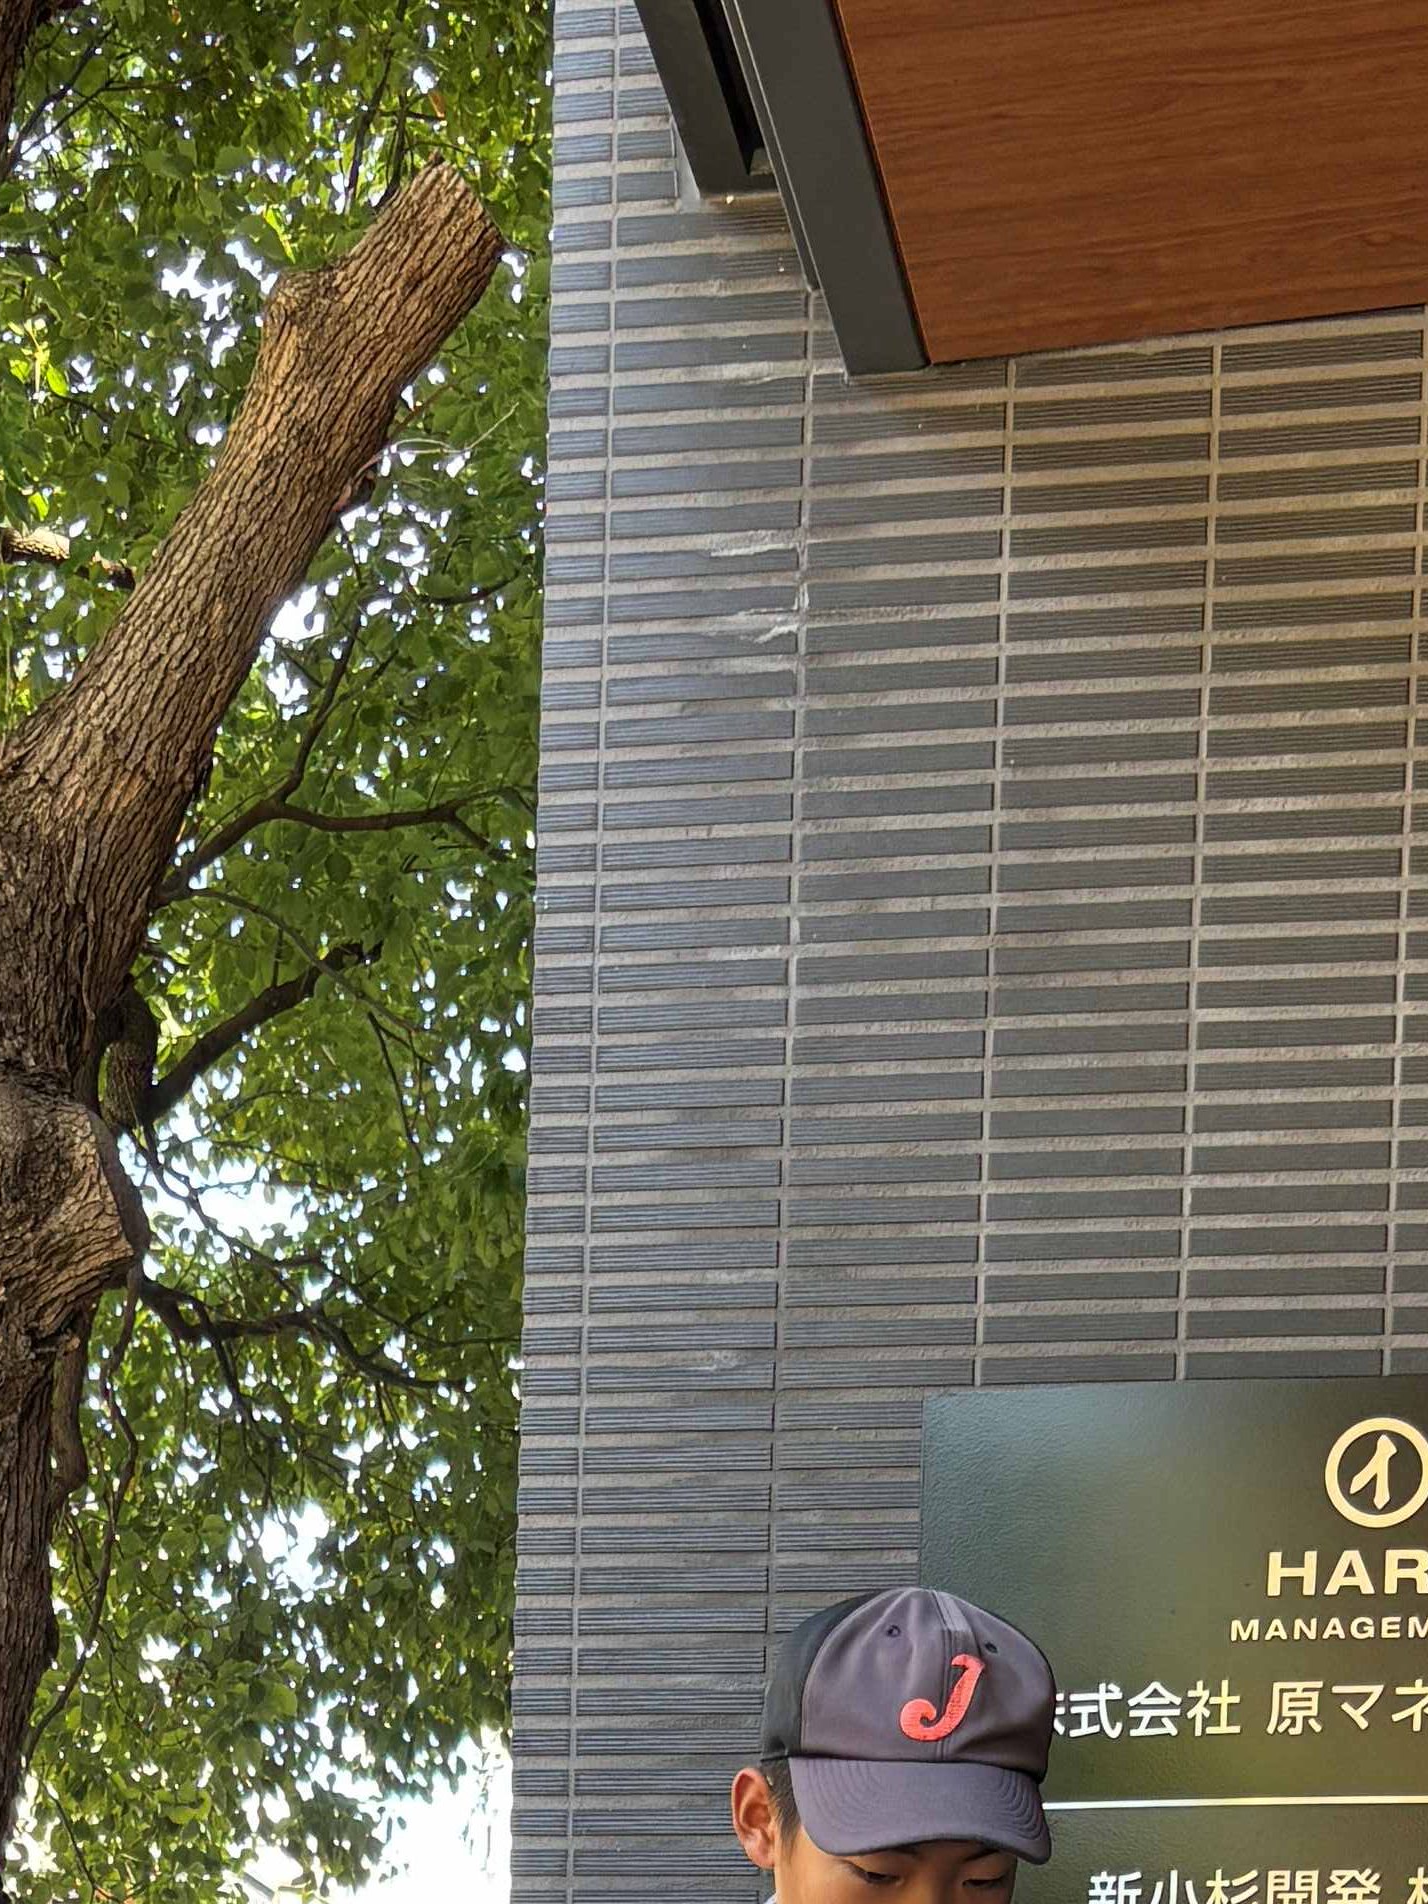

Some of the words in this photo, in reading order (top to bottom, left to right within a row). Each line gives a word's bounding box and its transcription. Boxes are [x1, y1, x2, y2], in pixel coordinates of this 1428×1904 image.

[900, 1653, 985, 1741] J
[1054, 1680, 1241, 1739] 式会社
